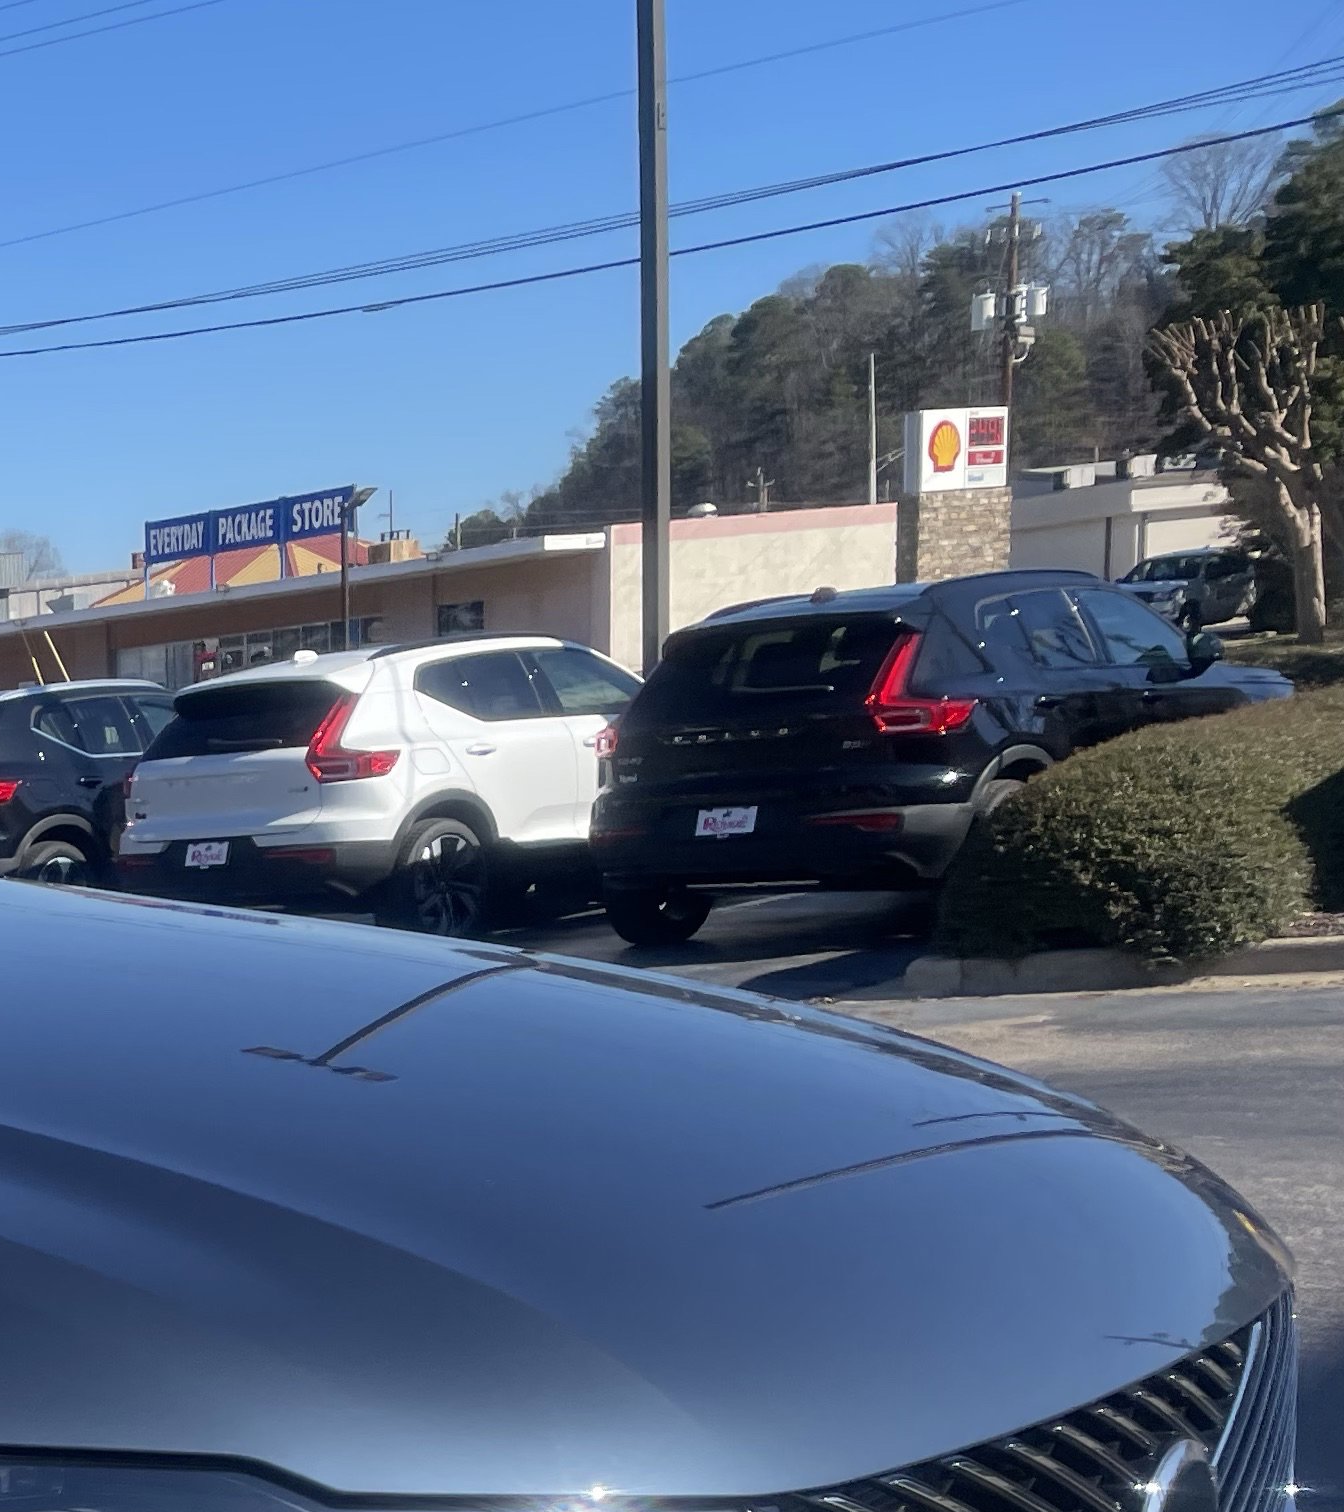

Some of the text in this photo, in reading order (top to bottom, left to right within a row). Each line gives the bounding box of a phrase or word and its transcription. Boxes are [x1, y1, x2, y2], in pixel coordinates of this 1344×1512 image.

[150, 496, 343, 556] EVERYDAY PACKAGE STORE
